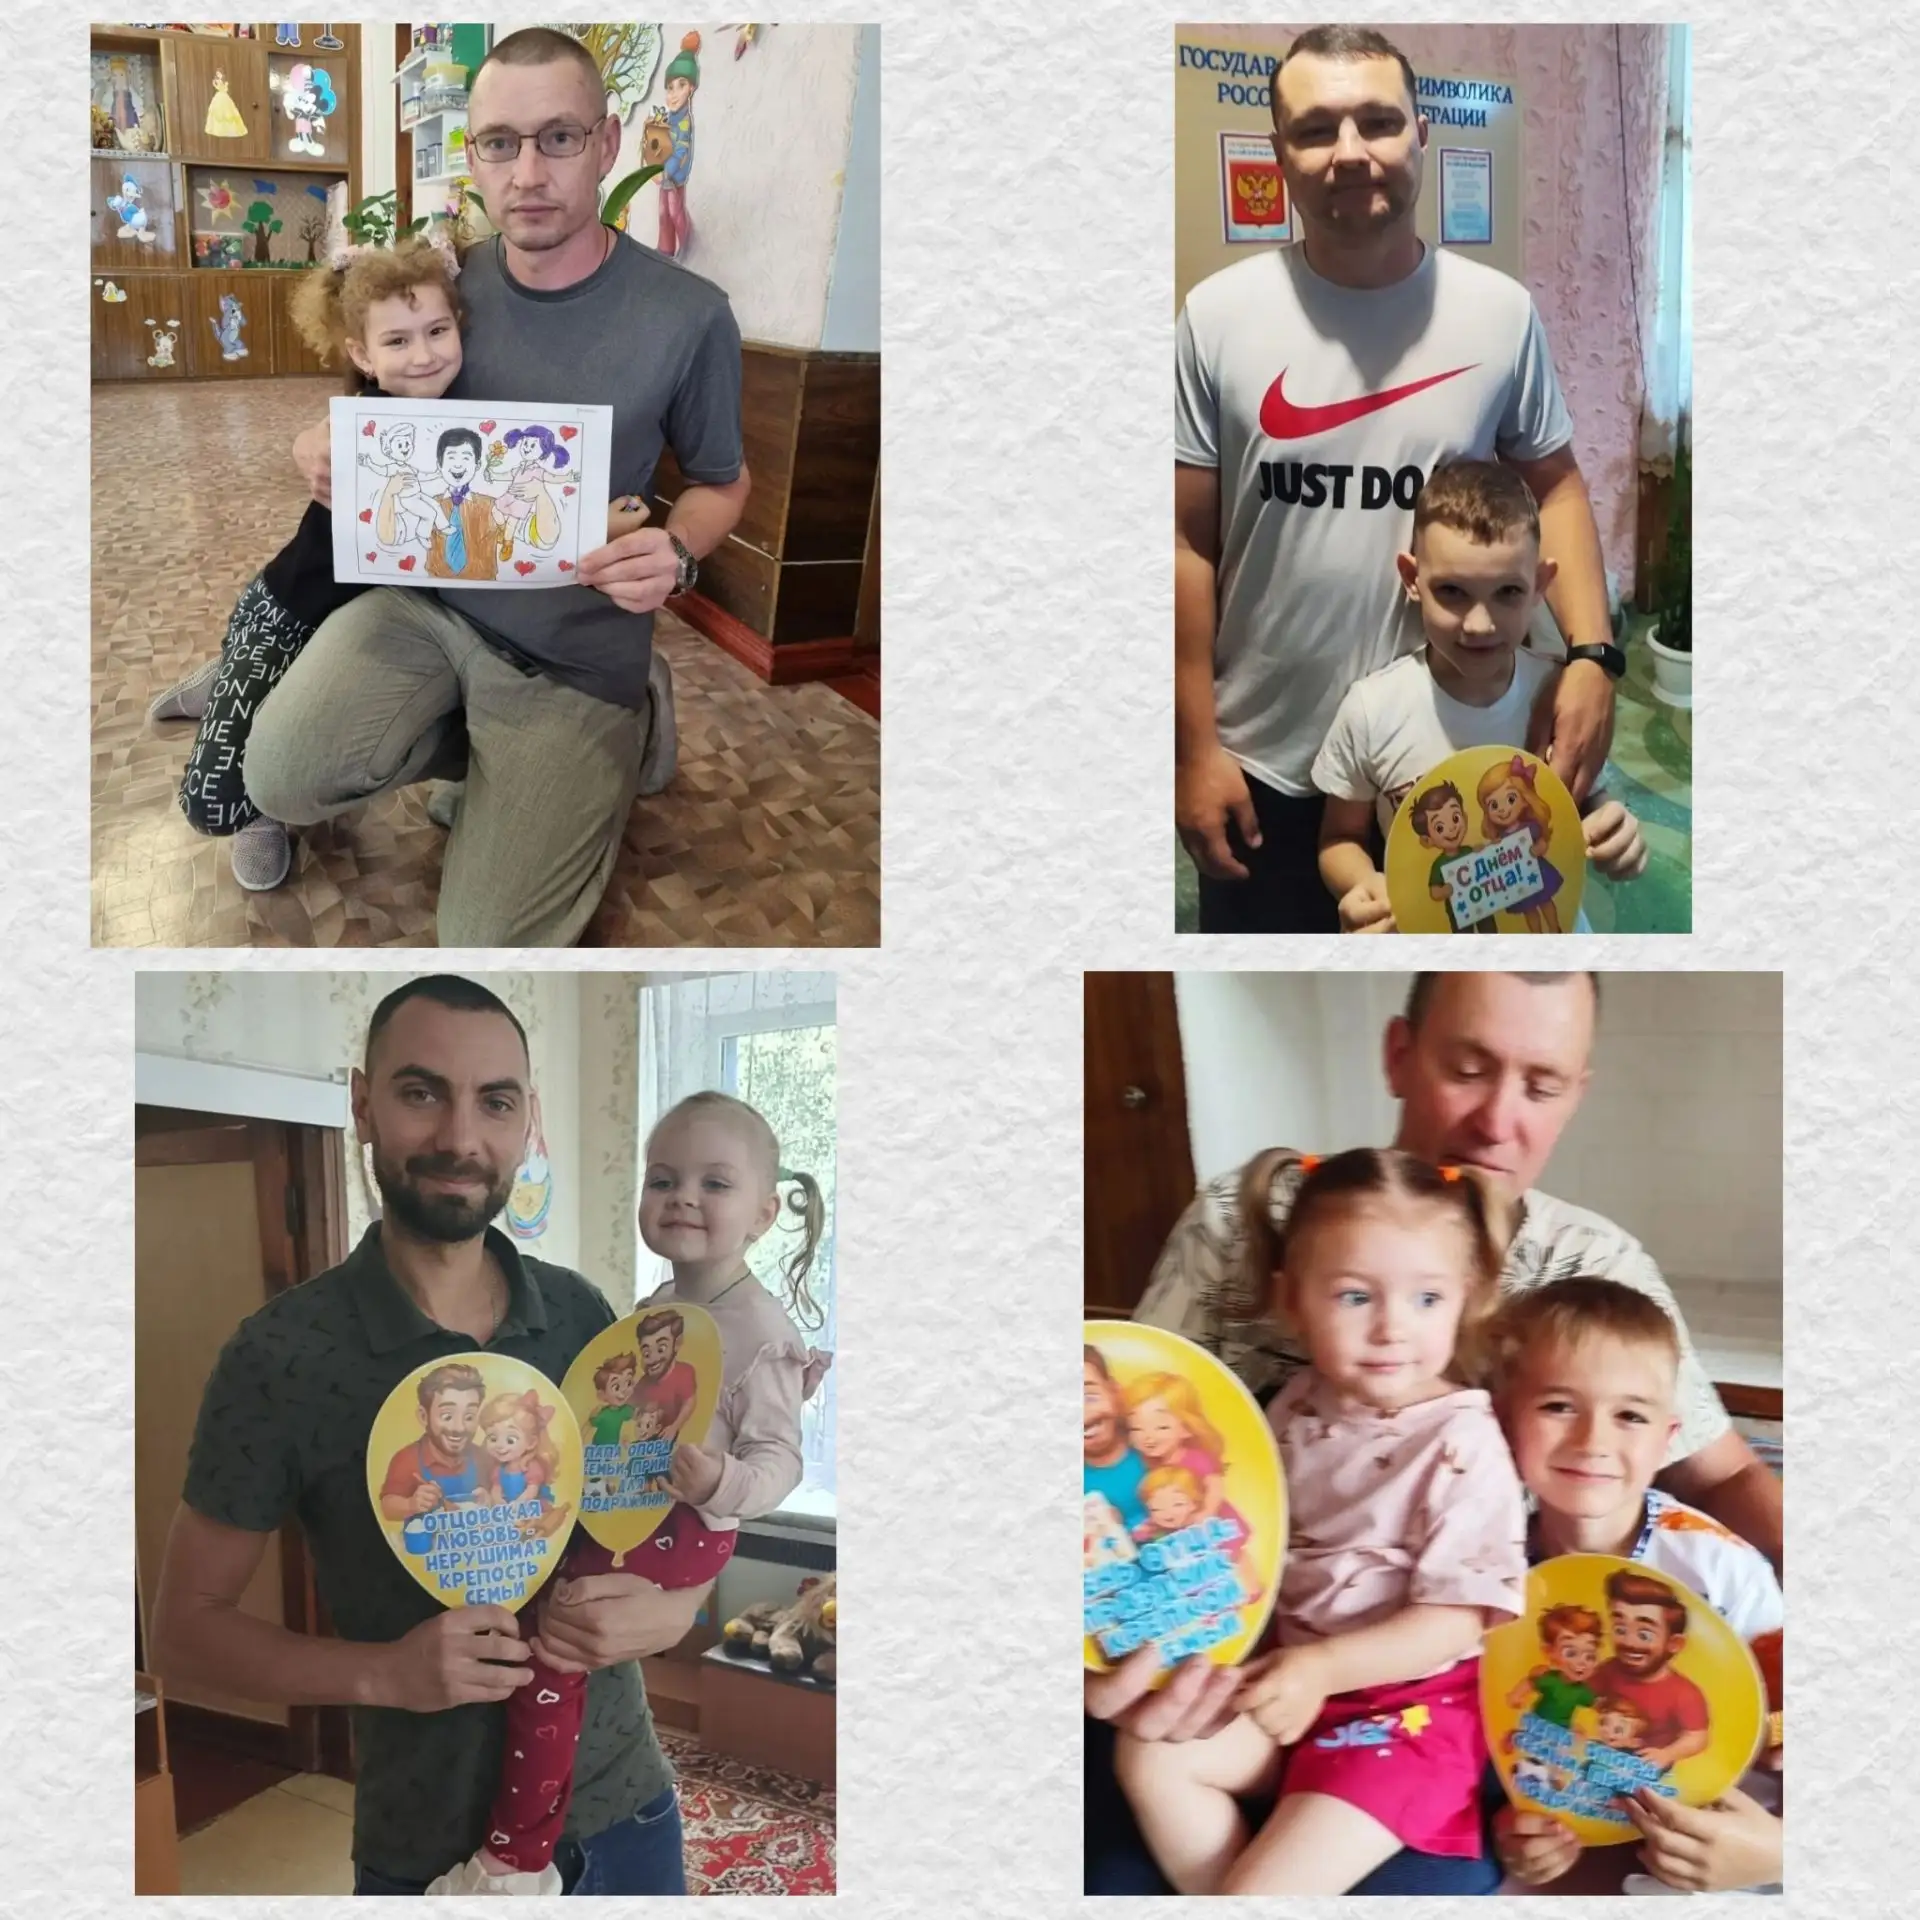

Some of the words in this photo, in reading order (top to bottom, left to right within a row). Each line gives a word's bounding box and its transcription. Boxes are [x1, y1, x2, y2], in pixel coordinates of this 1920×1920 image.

[1179, 45, 1277, 78] ГОСУДАР
[1417, 76, 1513, 104] ИМВОЛИКА
[1217, 82, 1271, 107] РОСС
[1259, 461, 1354, 508] JUST
[1360, 465, 1425, 510] DO
[1456, 865, 1472, 887] С
[1475, 845, 1523, 883] Днём
[423, 1500, 542, 1533] ОТЦОВСКАЯ
[437, 1526, 519, 1551] ЛЮБОВЬ
[426, 1540, 547, 1572] НЕРУШИМАЯ
[439, 1560, 539, 1589] КРЕПОСТЬ
[465, 1581, 526, 1606] СЕМЬИ
